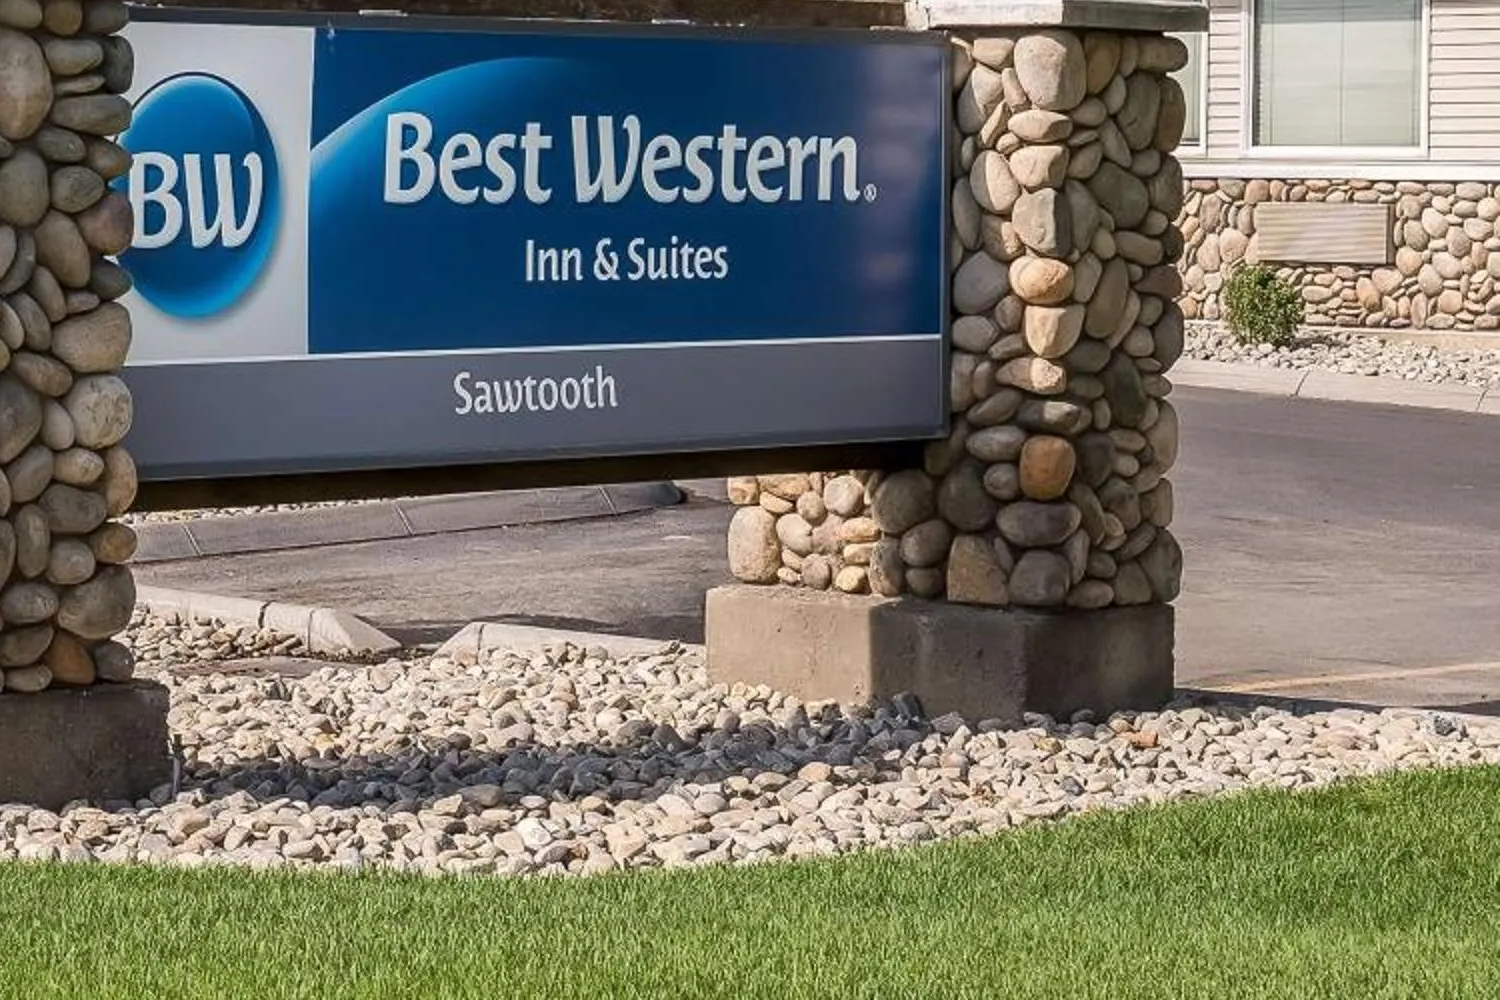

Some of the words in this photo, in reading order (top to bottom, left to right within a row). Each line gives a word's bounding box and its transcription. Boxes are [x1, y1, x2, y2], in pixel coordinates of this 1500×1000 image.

[384, 112, 552, 204] Best
[129, 152, 263, 249] BW
[526, 239, 583, 282] Inn
[593, 239, 621, 279] &
[628, 237, 729, 280] Suites
[454, 366, 618, 415] Sawtooth
